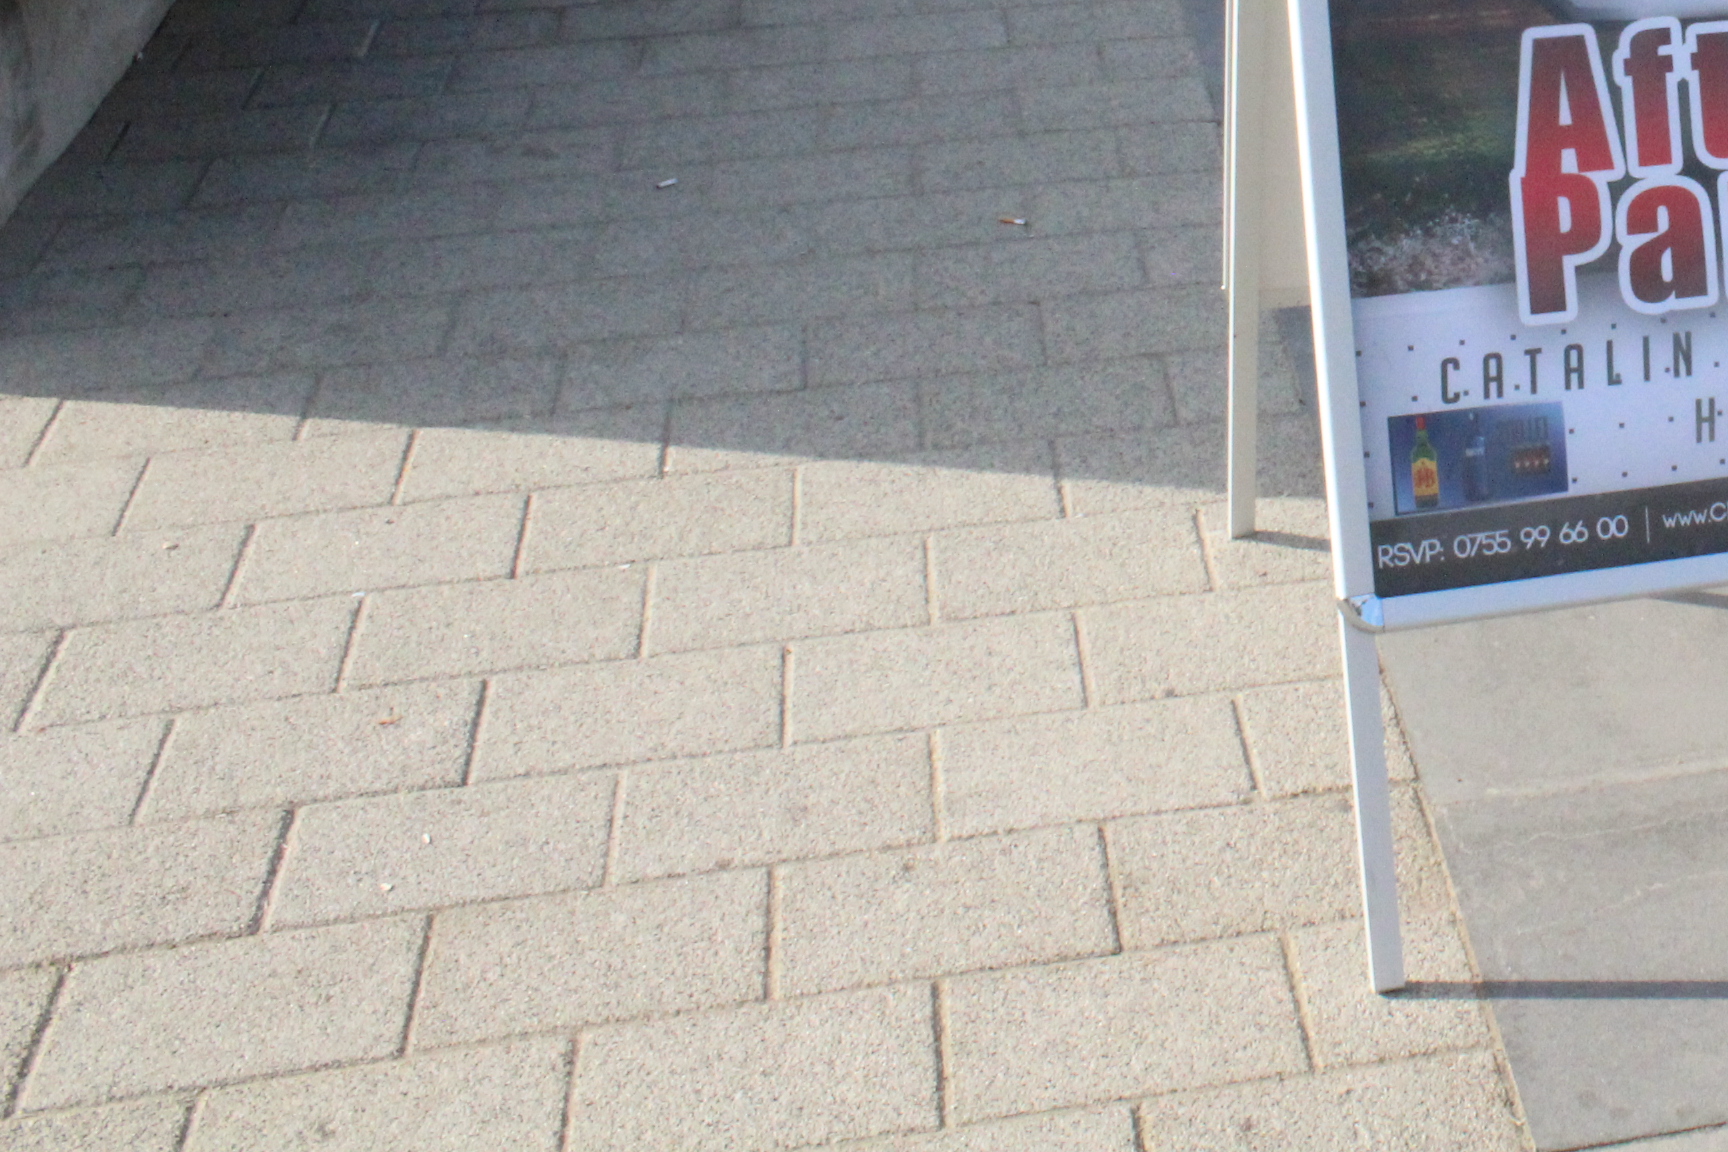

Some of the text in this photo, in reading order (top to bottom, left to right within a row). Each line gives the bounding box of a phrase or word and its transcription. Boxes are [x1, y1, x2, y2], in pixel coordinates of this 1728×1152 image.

[1441, 330, 1694, 405] CATALIN
[1377, 514, 1629, 570] RSVP: 0755 99 66 00
